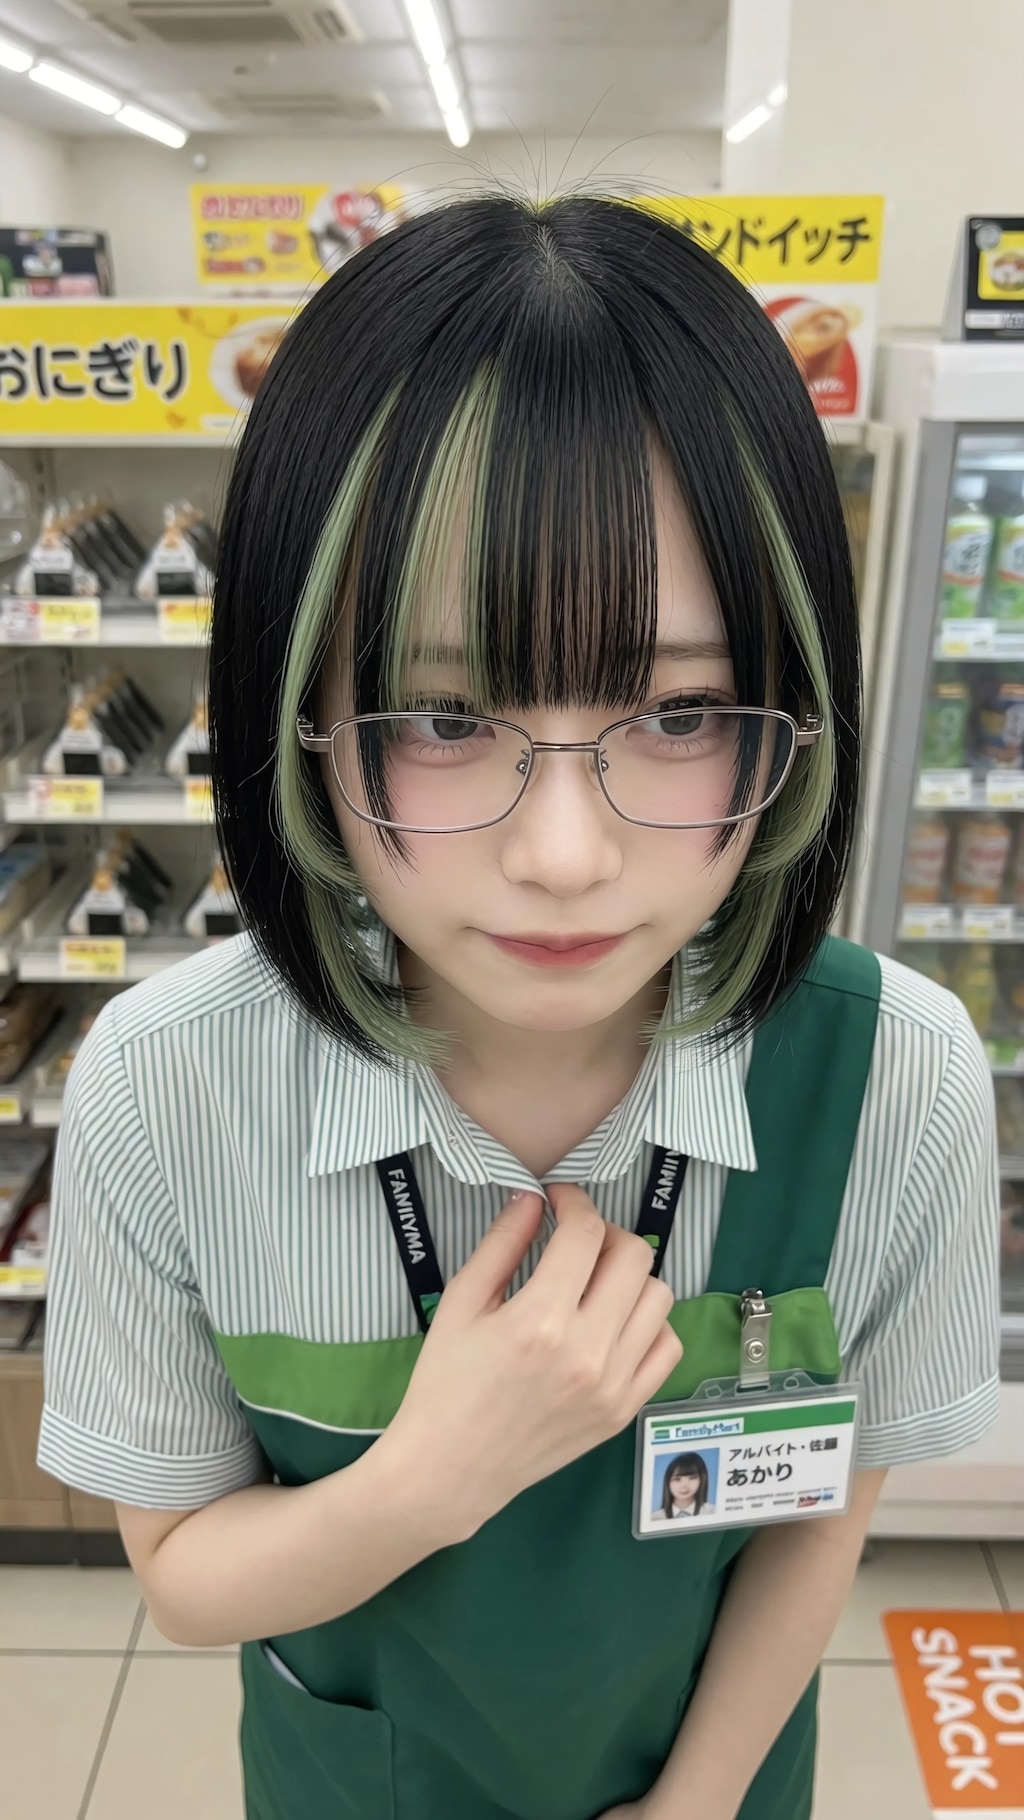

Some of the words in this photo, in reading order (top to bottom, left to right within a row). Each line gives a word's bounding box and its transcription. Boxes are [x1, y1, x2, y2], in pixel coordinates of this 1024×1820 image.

[682, 217, 870, 265] ンドイッチ
[726, 1462, 793, 1487] あかり
[911, 1626, 999, 1791] SNACK
